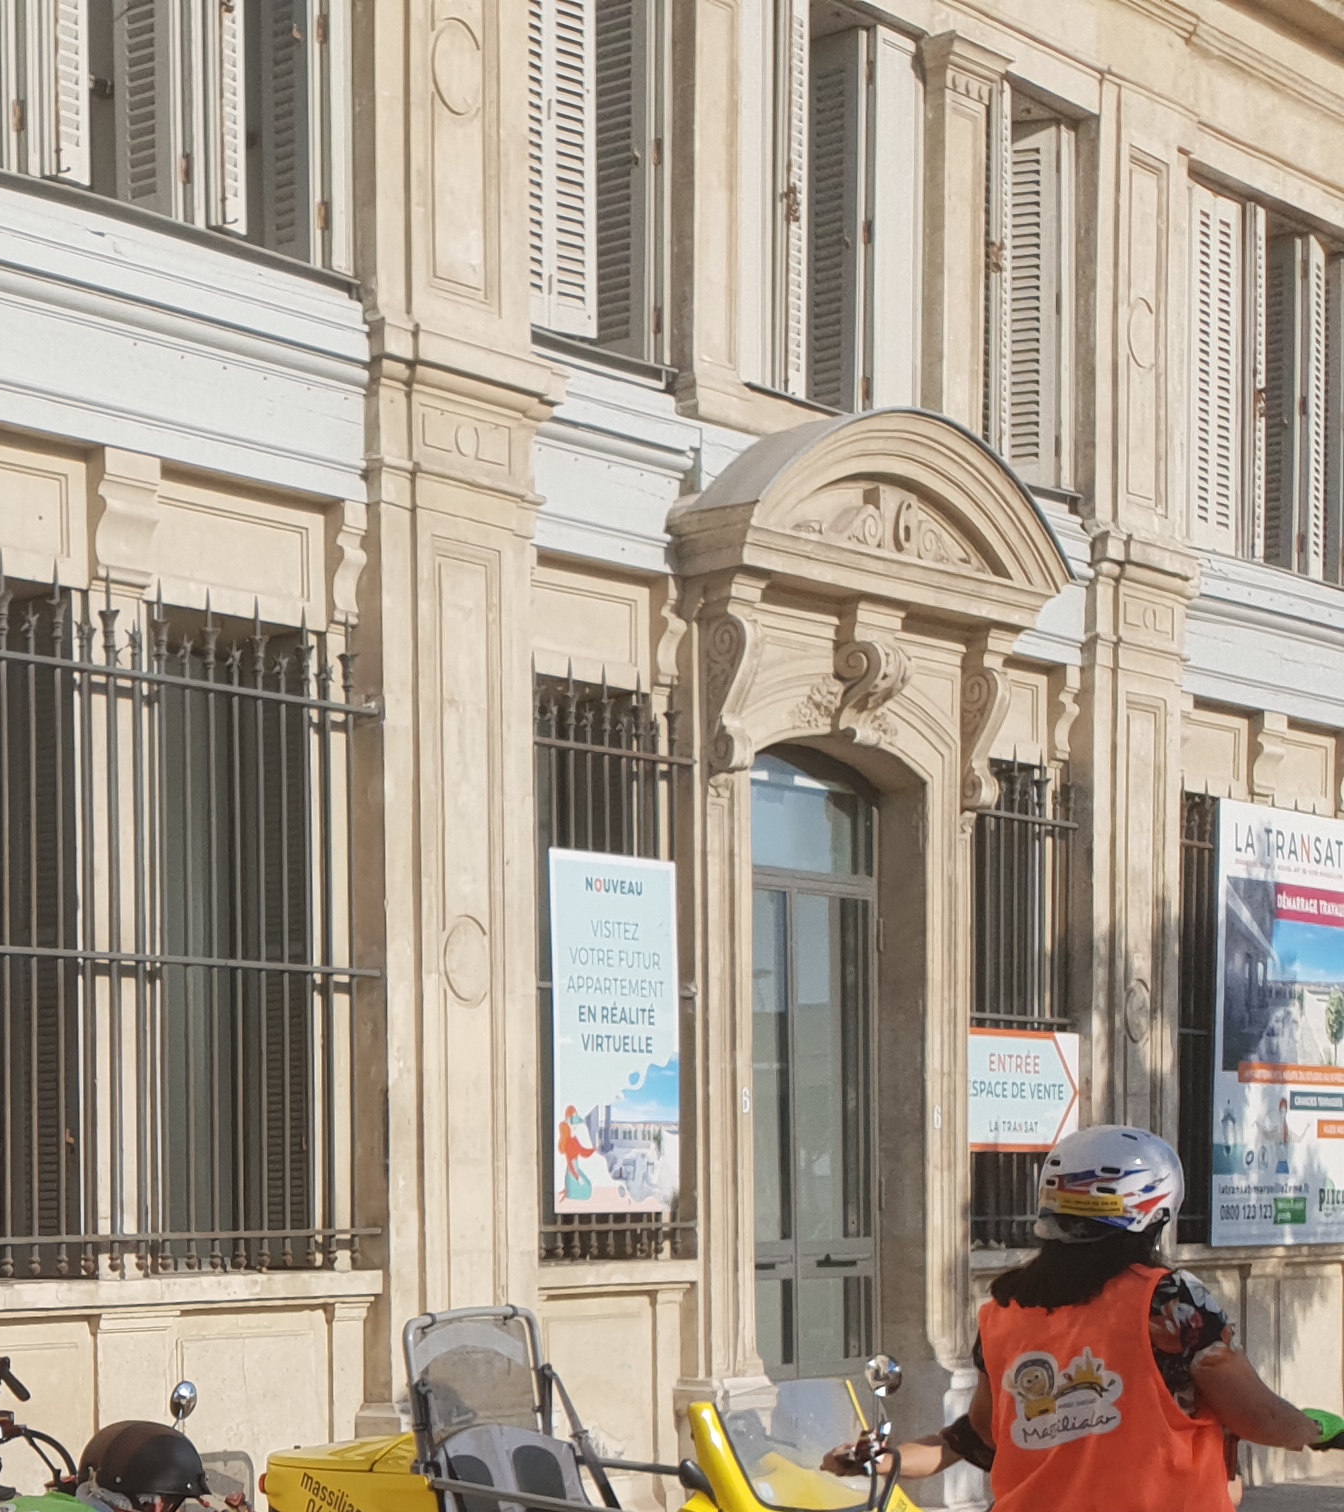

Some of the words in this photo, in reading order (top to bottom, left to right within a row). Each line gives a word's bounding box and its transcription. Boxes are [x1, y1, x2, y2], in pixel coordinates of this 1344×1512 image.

[1234, 821, 1256, 856] LA
[1264, 827, 1343, 868] TRANSAT
[585, 876, 643, 896] NOUVEAU
[590, 919, 640, 941] VISITEZ
[569, 946, 614, 968] VOTRE
[618, 950, 661, 970] FUTUR
[566, 974, 665, 998] APPARTEMENT
[578, 1004, 597, 1023] EN
[601, 1001, 655, 1026] RÉALITÉ
[581, 1033, 653, 1054] VIRTUELLE
[988, 1050, 1040, 1075] ENTRÉE
[741, 1086, 750, 1113] 6
[1011, 1081, 1026, 1099] DE
[1029, 1083, 1064, 1101] VENTE
[933, 1105, 942, 1129] 6
[988, 1120, 999, 1133] LA
